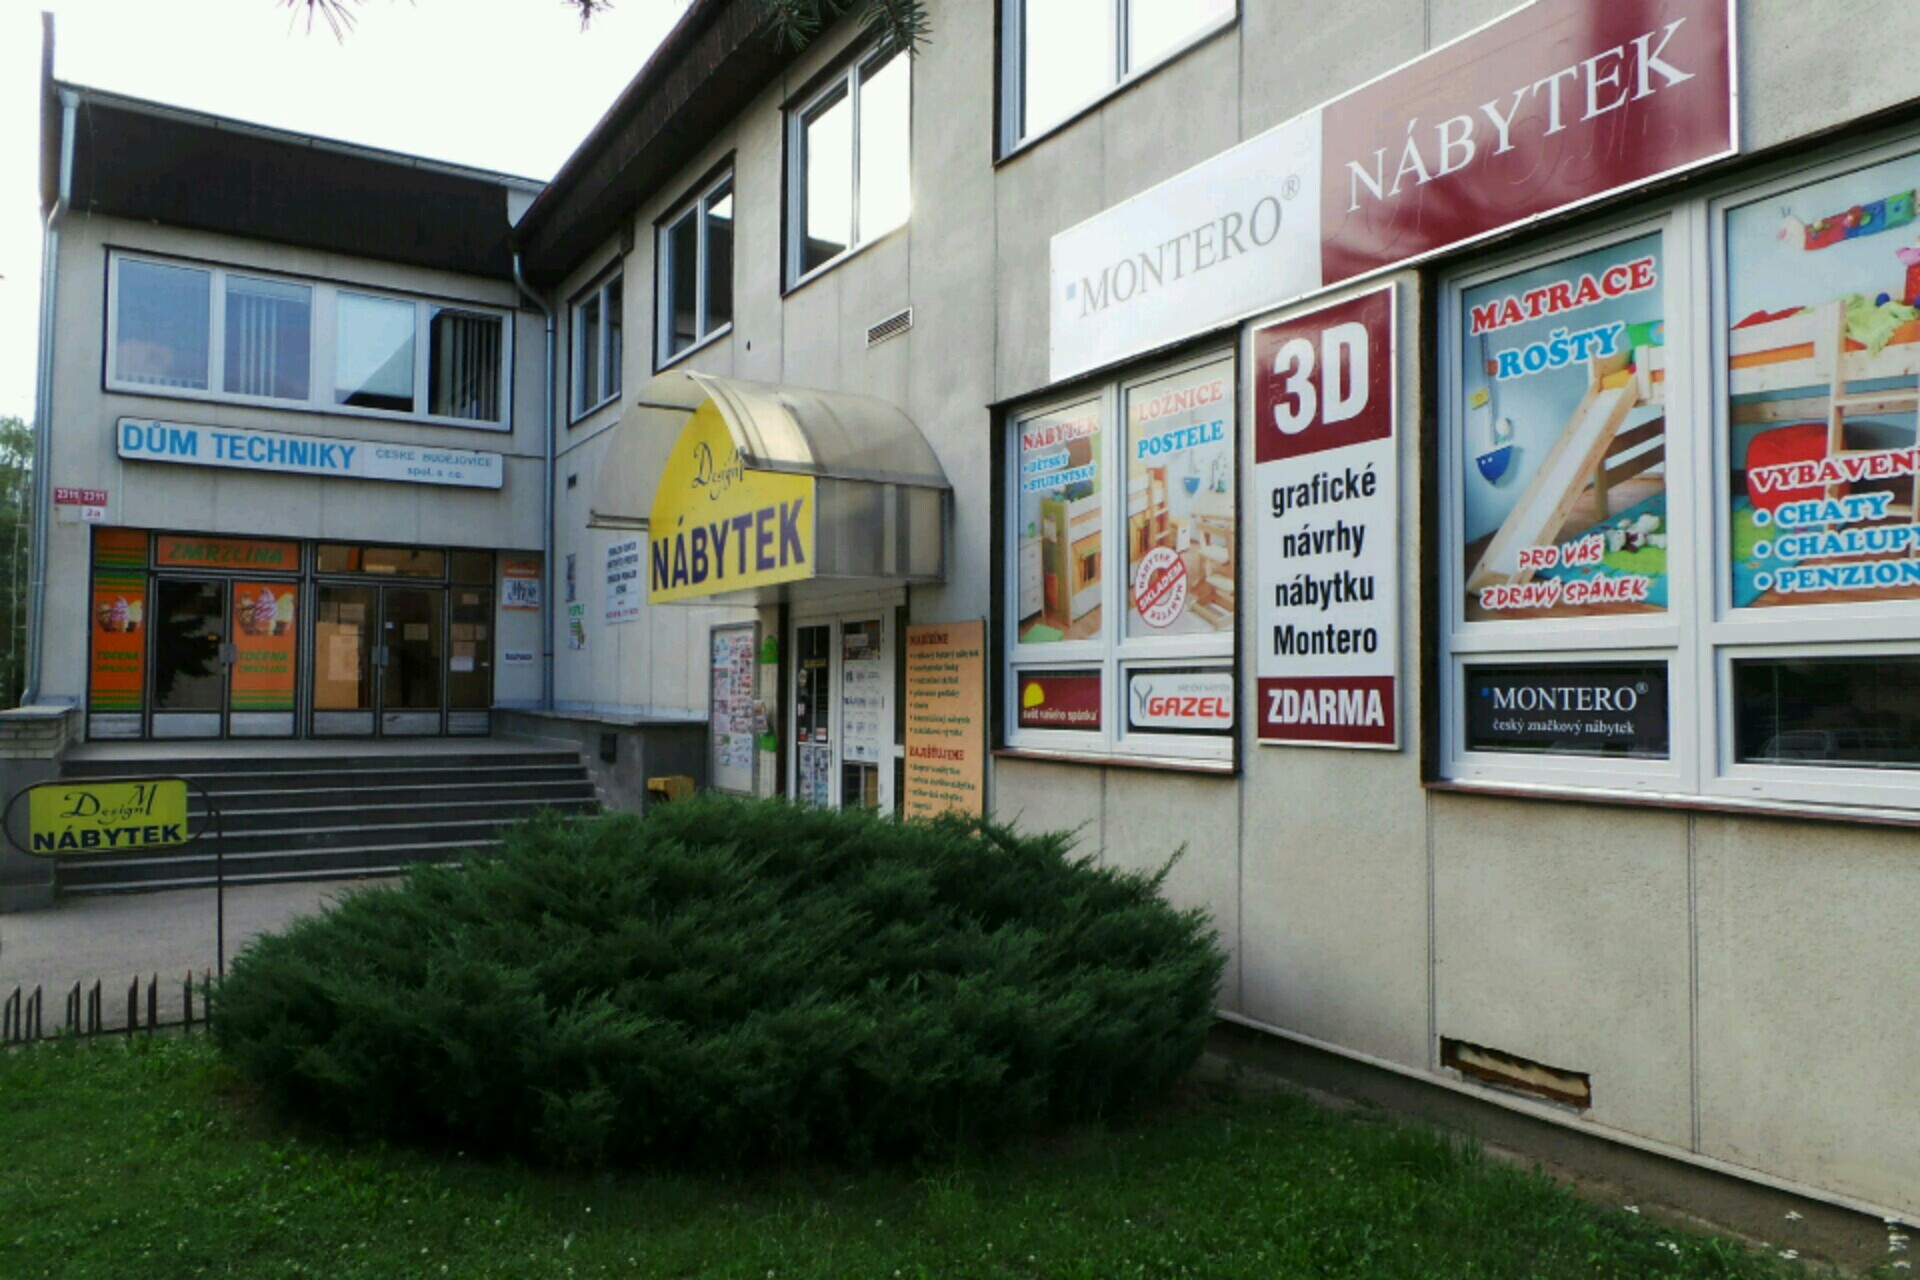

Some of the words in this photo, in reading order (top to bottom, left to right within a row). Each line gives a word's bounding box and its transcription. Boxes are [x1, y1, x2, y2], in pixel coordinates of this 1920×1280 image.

[1345, 18, 1695, 213] NÁBYTEK
[1472, 258, 1655, 334] MATRACE
[1498, 323, 1623, 379] ROŠTY
[1273, 321, 1369, 436] 3D
[1138, 380, 1224, 422] LOŽNICE
[122, 421, 198, 456] DŮM
[211, 432, 357, 469] TECHNIKY
[1023, 414, 1099, 451] NÁBYTEK
[1137, 419, 1225, 459] POSTELE
[1030, 462, 1096, 491] STUDENTSKÝ
[1271, 462, 1377, 519] grafické
[1777, 495, 1890, 524] CHATY
[169, 542, 284, 565] ZMRZLINA
[652, 496, 806, 592] NÁBYTEK
[1282, 520, 1365, 559] návrhy
[1519, 549, 1557, 568] PRO
[1563, 535, 1602, 564] VÁŠ
[1139, 560, 1184, 611] SKLADEM
[1274, 570, 1374, 611] nábytku
[1482, 578, 1560, 607] ZDRAVÝ
[1565, 576, 1647, 603] SPÁNEK
[1273, 625, 1377, 656] Montero
[1148, 696, 1231, 719] GAZEL
[1267, 688, 1385, 727] ZDARMA
[1492, 717, 1525, 734] český
[1527, 719, 1582, 736] značkový
[1585, 719, 1635, 737] nábytek
[60, 790, 145, 825] Design
[32, 823, 182, 852] NÁBYTEK
